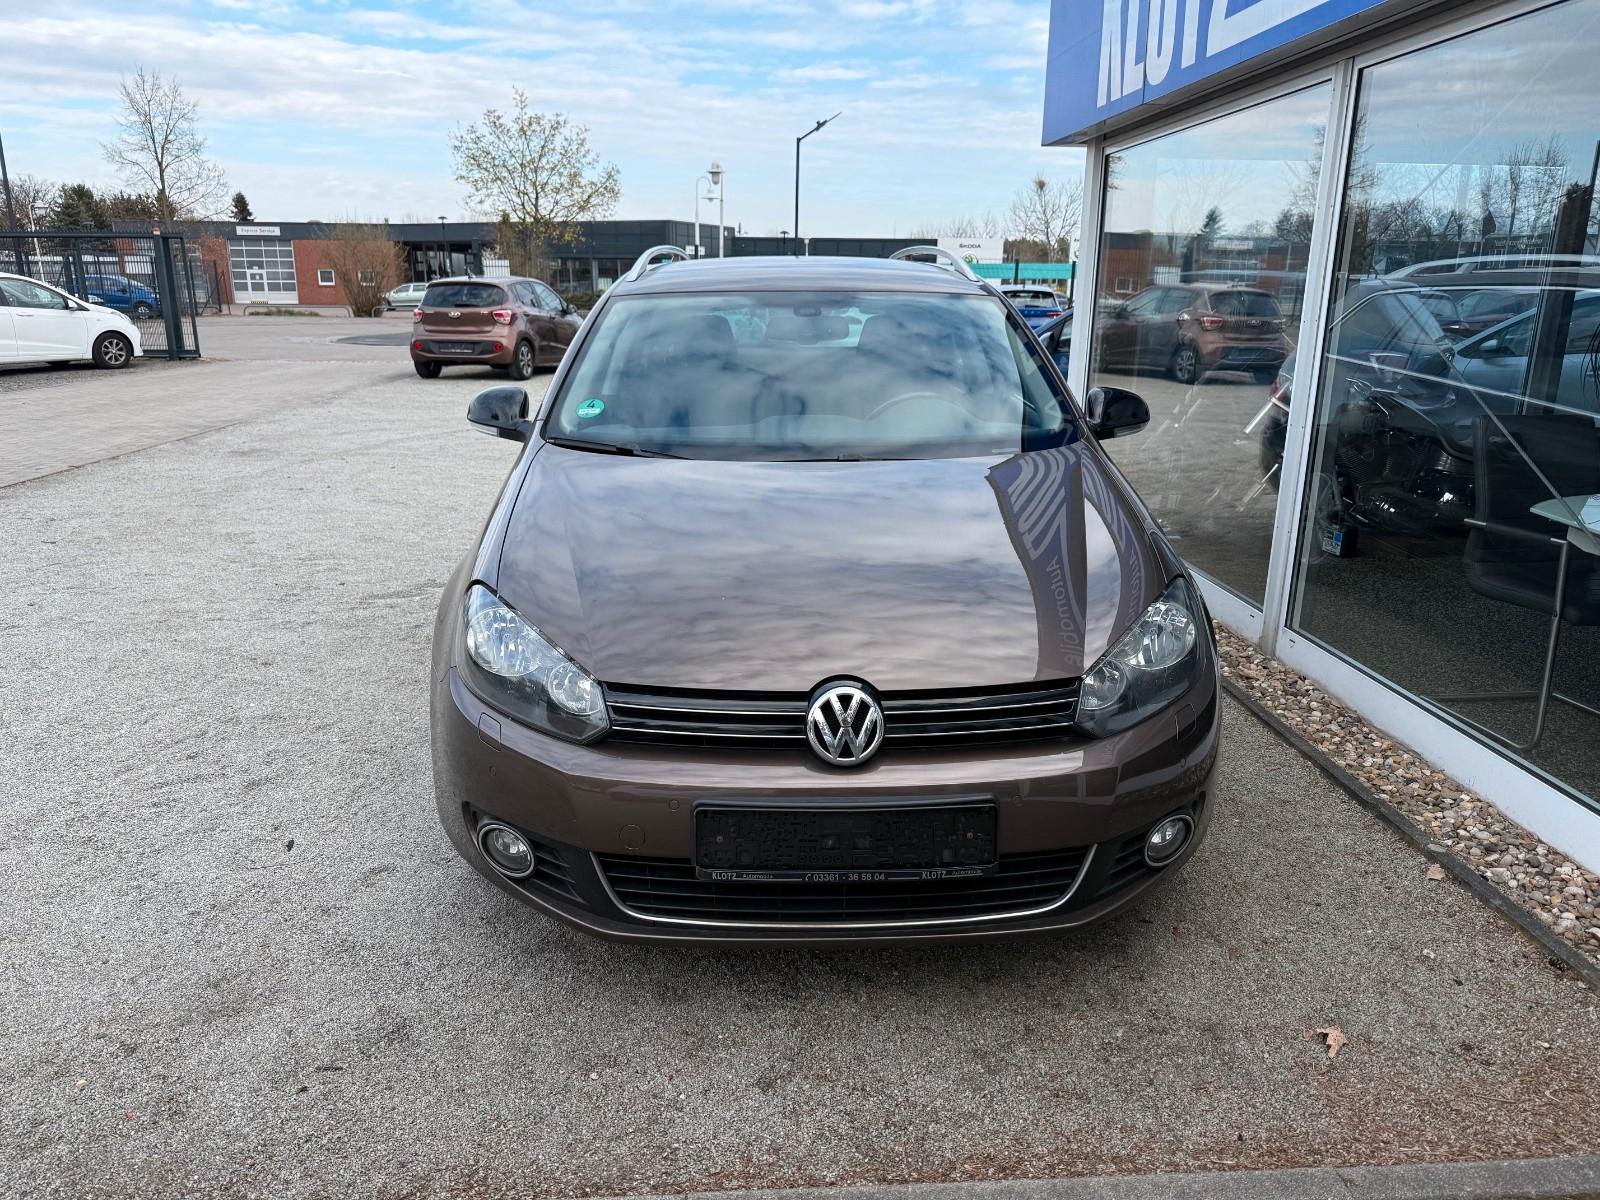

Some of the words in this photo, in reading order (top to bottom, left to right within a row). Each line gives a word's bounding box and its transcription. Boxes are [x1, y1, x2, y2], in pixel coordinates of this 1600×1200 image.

[586, 399, 596, 408] 4
[712, 872, 737, 880] KLOTZ
[813, 873, 839, 881] 03361
[848, 873, 859, 881] 36
[861, 873, 872, 881] 58
[874, 873, 885, 881] 04
[921, 871, 946, 880] KLOTZ
